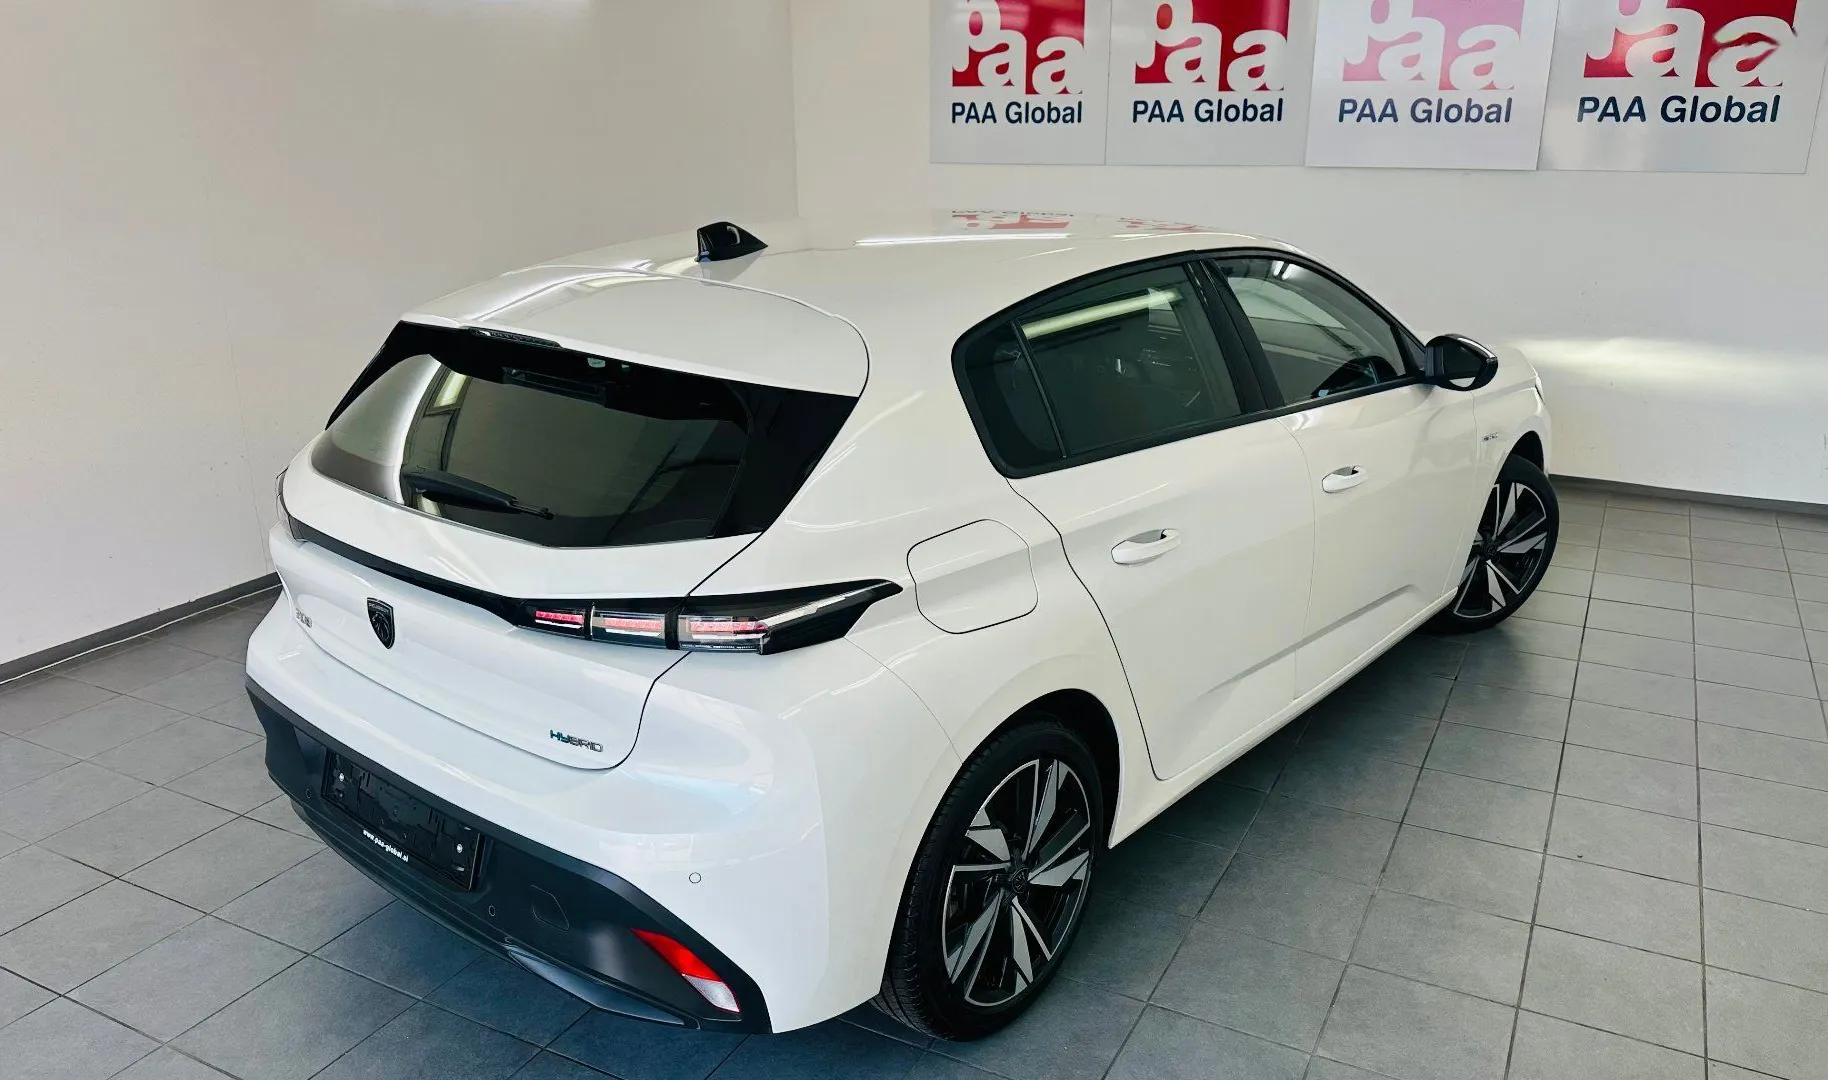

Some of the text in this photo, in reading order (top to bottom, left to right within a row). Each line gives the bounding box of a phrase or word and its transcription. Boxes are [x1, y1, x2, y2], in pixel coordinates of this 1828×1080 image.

[951, 101, 1083, 124] PAA Global
[1132, 97, 1284, 123] PAA Global
[1338, 97, 1513, 124] PAA Global
[1577, 95, 1781, 124] PAA Global
[549, 729, 603, 753] HYBRID
